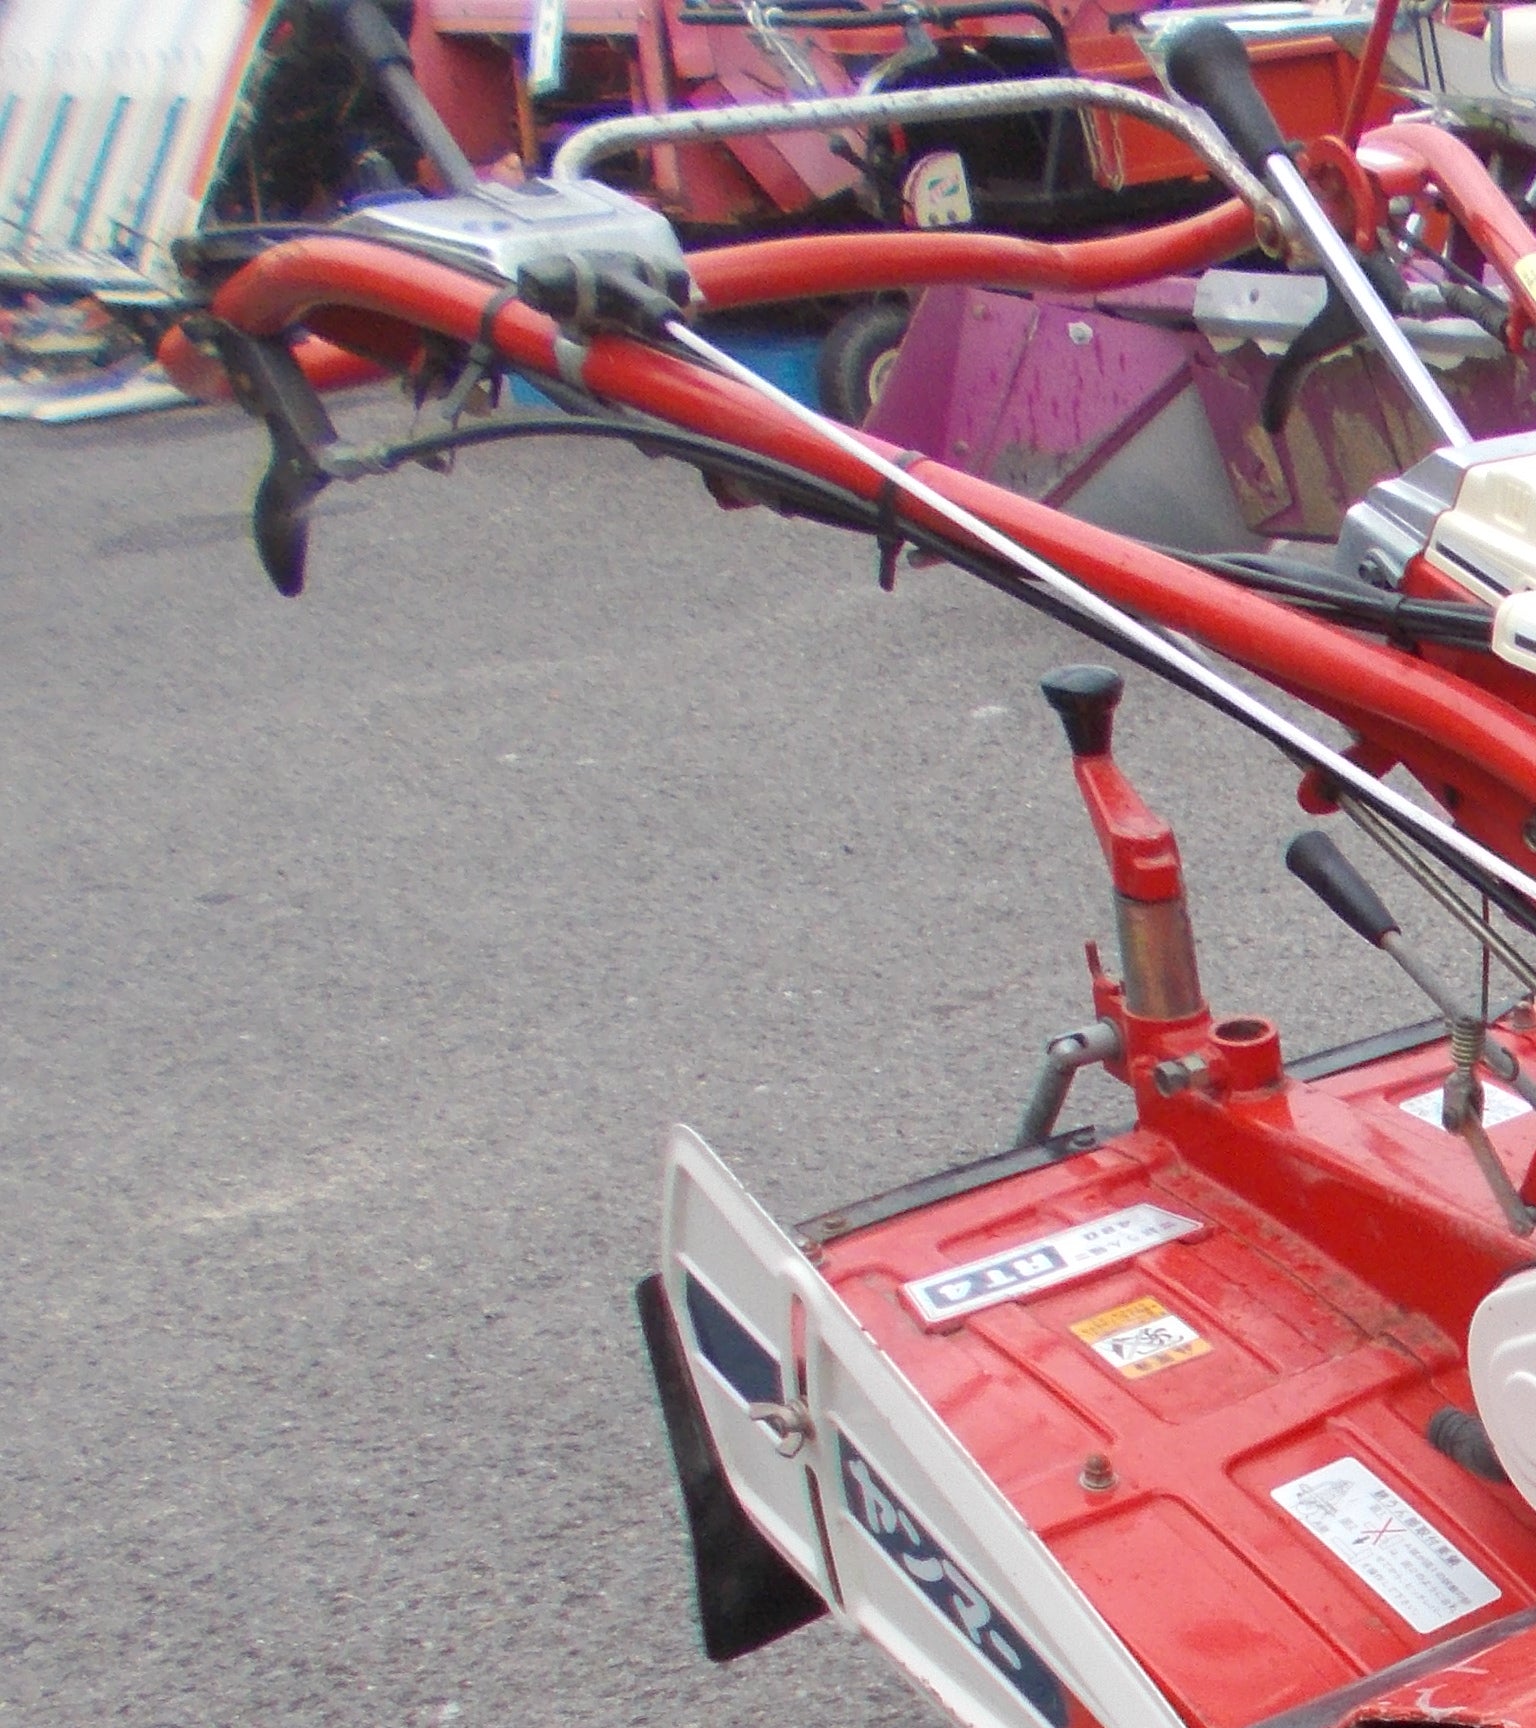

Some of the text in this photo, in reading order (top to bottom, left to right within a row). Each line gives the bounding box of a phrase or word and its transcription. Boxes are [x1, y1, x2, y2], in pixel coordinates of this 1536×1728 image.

[939, 1253, 1053, 1301] RT4
[844, 1452, 1028, 1677] ヤンマー
